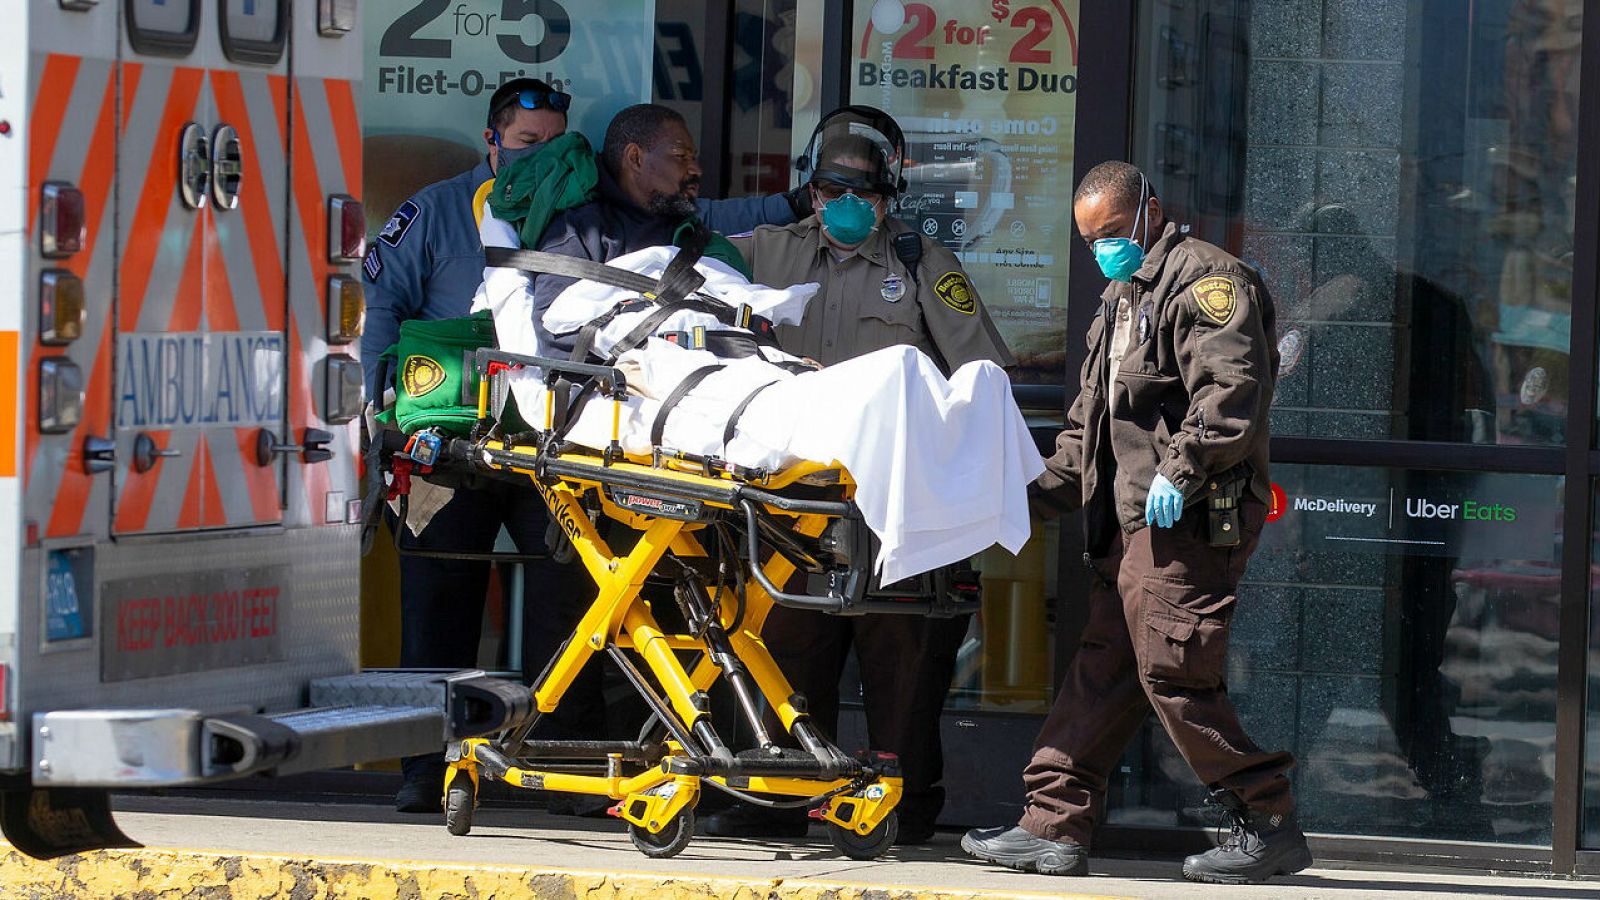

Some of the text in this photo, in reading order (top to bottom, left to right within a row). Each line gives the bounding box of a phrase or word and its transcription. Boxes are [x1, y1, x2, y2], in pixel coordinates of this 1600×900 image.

[380, 0, 571, 64] 2 for 5
[891, 3, 938, 60] 2
[943, 19, 992, 45] for
[858, 62, 1078, 94] Breakfast Duo
[118, 336, 281, 426] AMBULANCE
[1293, 497, 1517, 522] McDelivery Uber Eats
[116, 586, 281, 652] KEEP BACK 300 FEET
